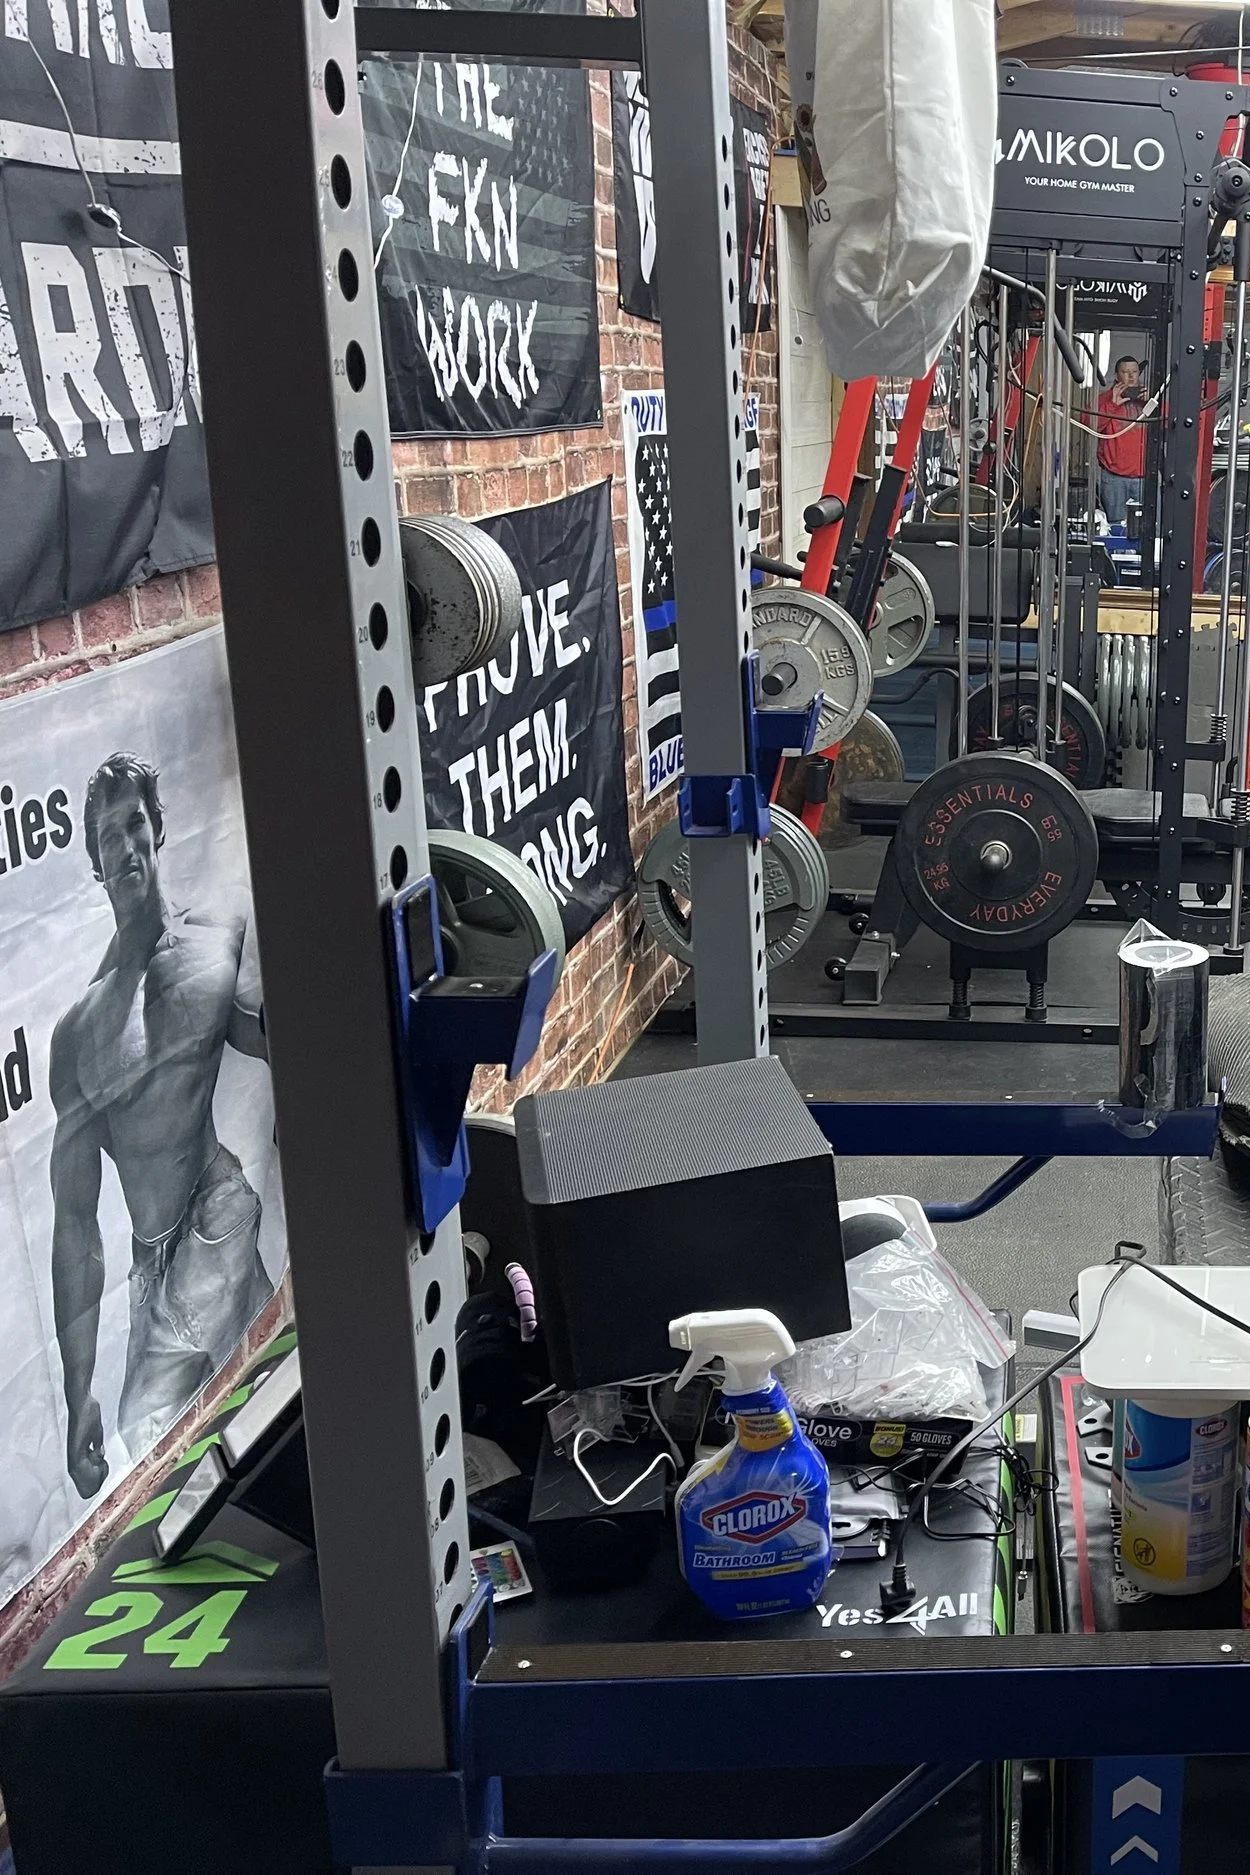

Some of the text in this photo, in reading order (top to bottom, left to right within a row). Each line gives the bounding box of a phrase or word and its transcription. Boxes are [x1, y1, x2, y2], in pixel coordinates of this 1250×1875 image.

[1007, 128, 1165, 171] MIKOLO
[1024, 176, 1135, 193] YOUR HOME GYM MASTER
[428, 150, 518, 272] FKN
[415, 284, 540, 409] WORK
[334, 358, 345, 376] 23
[342, 450, 353, 467] 22
[350, 540, 361, 557] 21
[358, 626, 369, 644] 20
[826, 664, 856, 680] KGS
[366, 710, 375, 728] 19
[448, 697, 578, 838] THEM.
[650, 737, 684, 791] BLUE
[373, 792, 382, 810] 18
[925, 784, 1034, 847] ESSENTIALS
[1041, 815, 1057, 830] LB
[933, 877, 950, 891] KG
[970, 871, 1062, 922] EVERYDAY
[911, 1432, 952, 1446] 50 GLOVES
[712, 1493, 796, 1537] CLOROX
[694, 1552, 776, 1568] BATHROOM
[42, 1589, 248, 1671] 24
